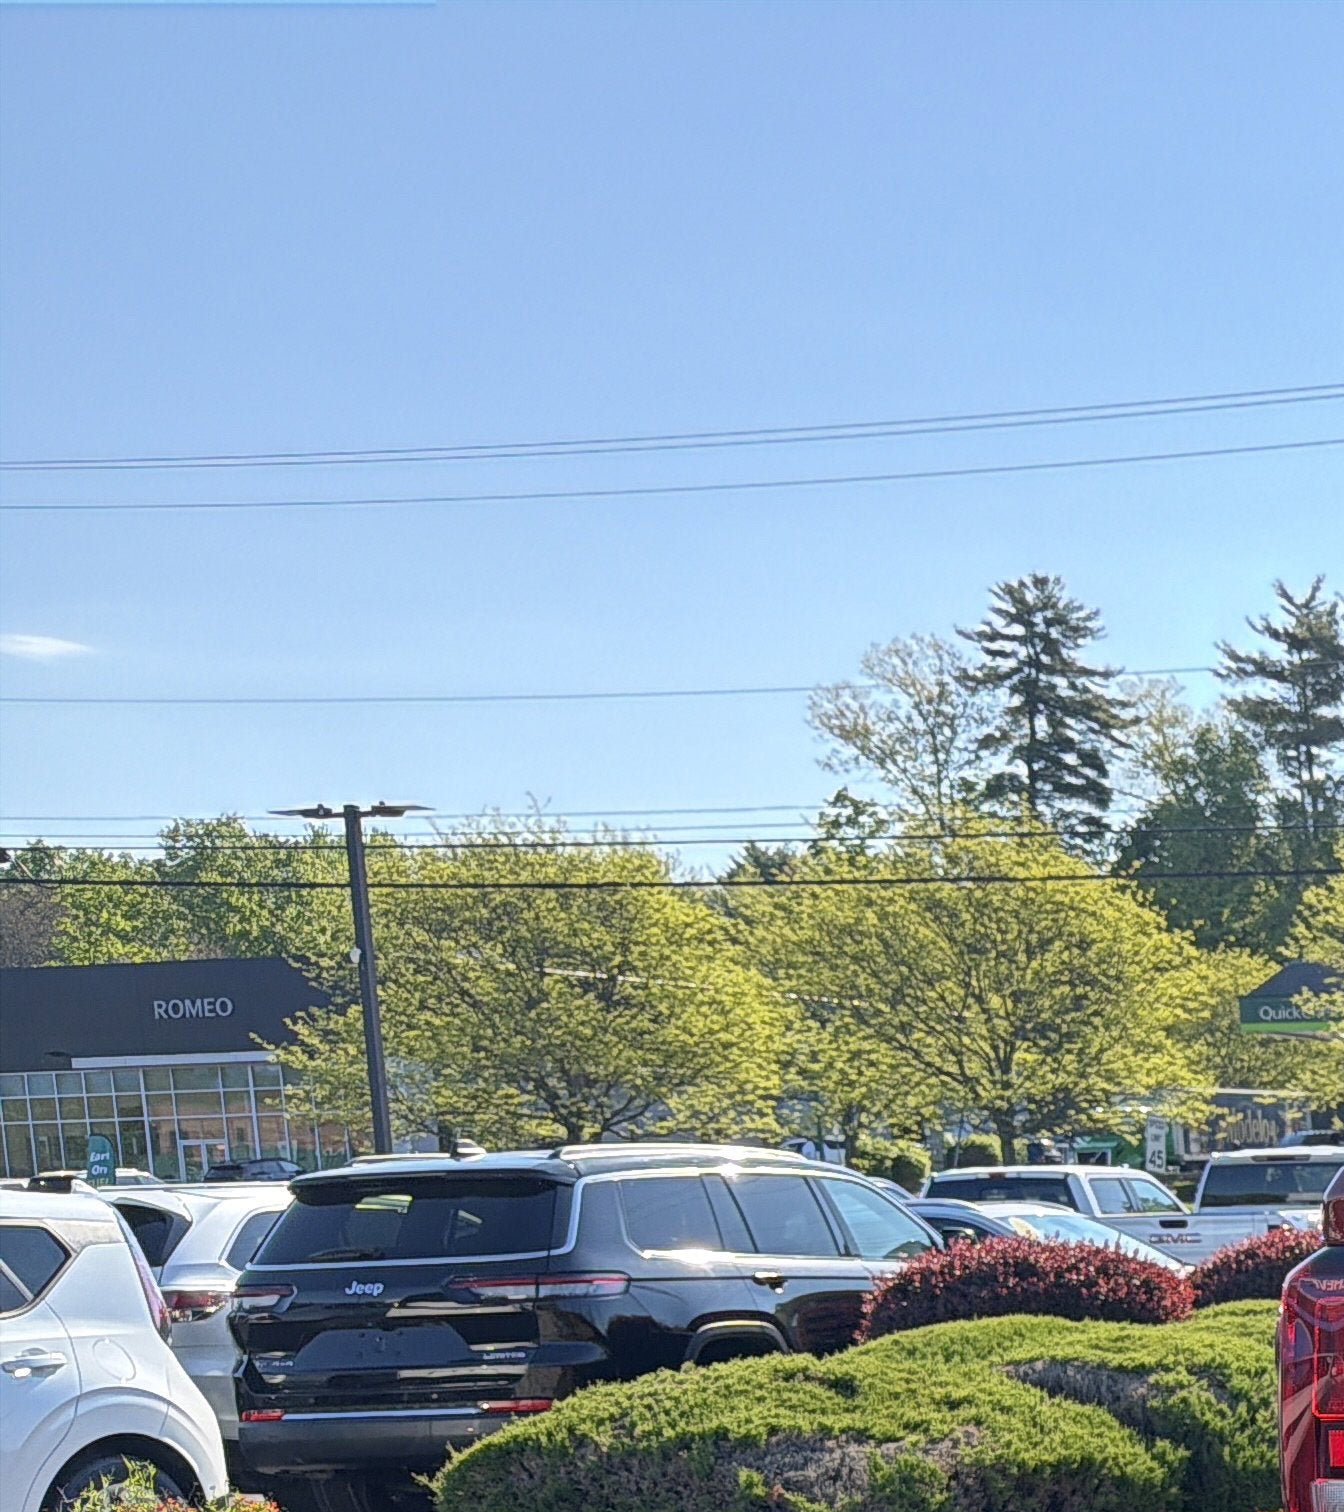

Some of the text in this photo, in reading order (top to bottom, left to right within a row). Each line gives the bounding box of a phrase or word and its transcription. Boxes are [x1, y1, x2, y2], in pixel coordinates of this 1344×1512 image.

[153, 997, 234, 1020] ROMEO
[1149, 1150, 1164, 1169] 45
[92, 1165, 108, 1175] On
[344, 1280, 385, 1297] Jeep
